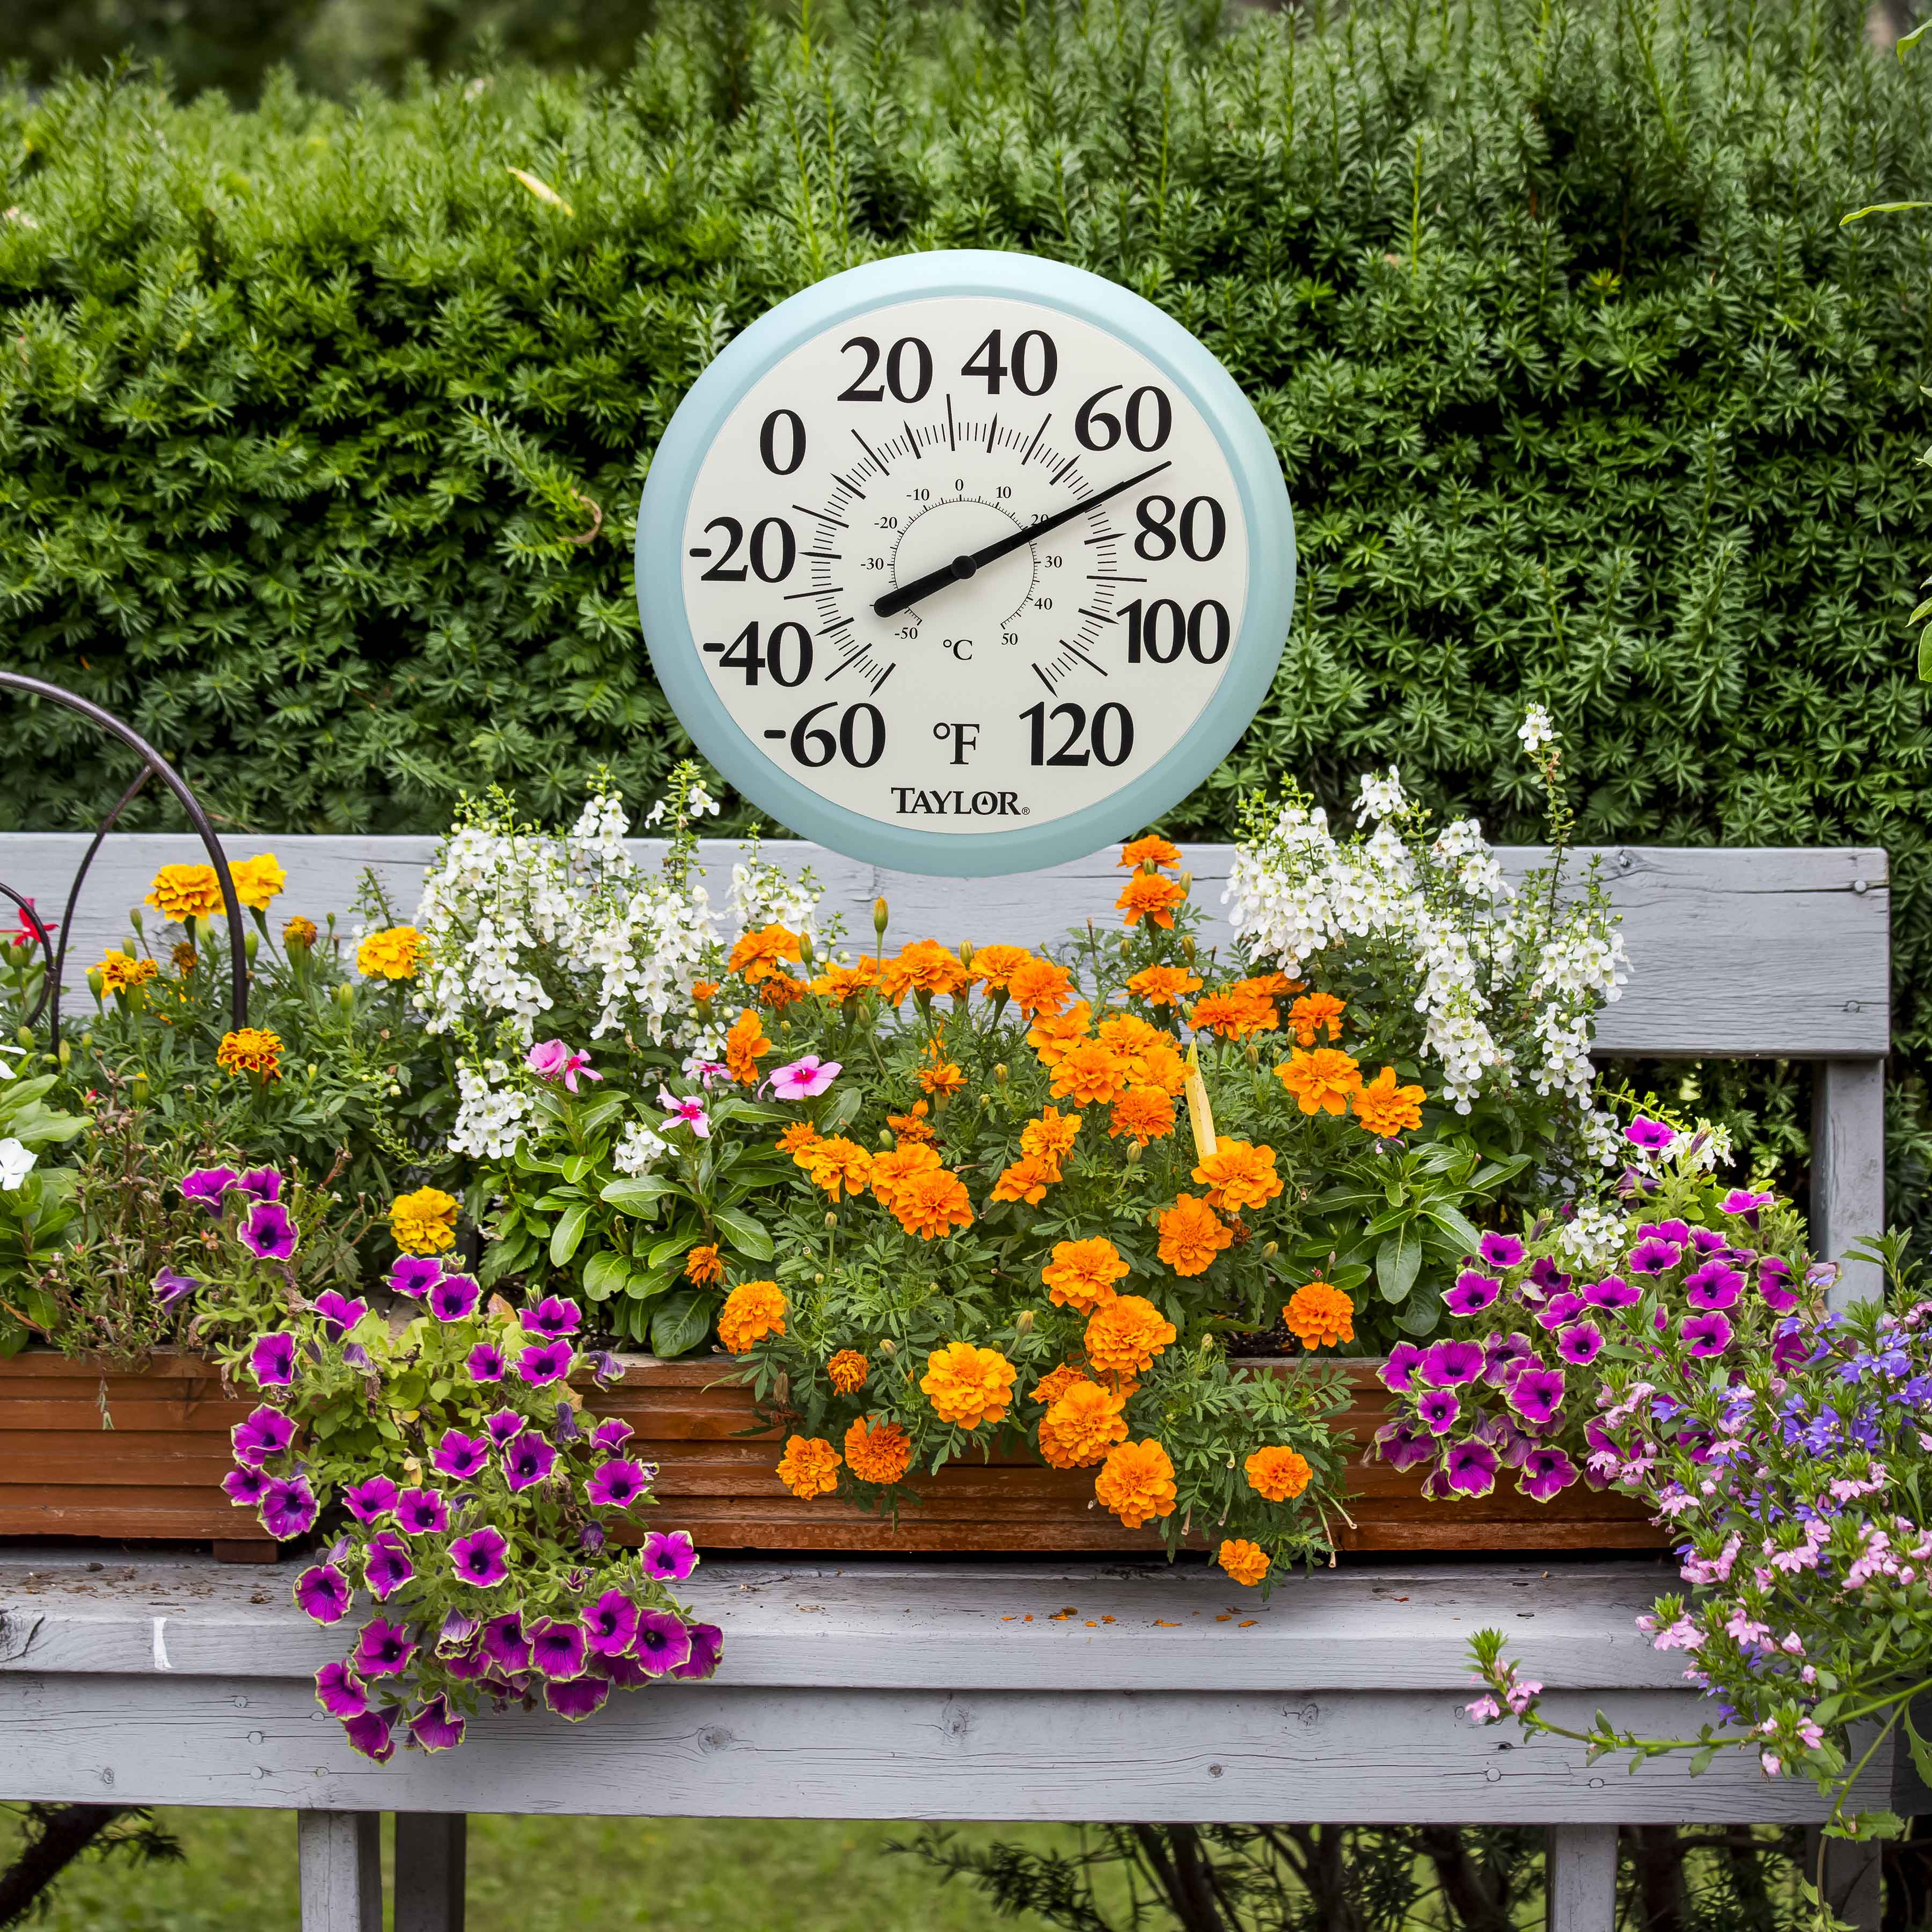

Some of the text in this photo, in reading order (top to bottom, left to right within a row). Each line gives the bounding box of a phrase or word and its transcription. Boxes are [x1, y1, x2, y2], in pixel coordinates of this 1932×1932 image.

[837, 336, 933, 404] 20
[961, 329, 1058, 397] 40
[1074, 385, 1172, 452] 60
[759, 409, 806, 475] 0
[906, 488, 930, 501] -10
[955, 479, 964, 491] 0
[996, 486, 1012, 499] 10
[874, 516, 897, 529] -20
[1134, 495, 1226, 562] 80
[689, 517, 796, 583] -20
[860, 558, 884, 570] -30
[1044, 555, 1063, 568] 30
[1034, 597, 1052, 610] 40
[894, 627, 918, 640] -50
[942, 639, 972, 661] °C
[1001, 633, 1018, 645] 50
[1116, 598, 1230, 664] 100
[702, 621, 814, 687] -40
[764, 701, 887, 769] -60
[933, 722, 980, 765] °F
[1019, 701, 1134, 767] 120
